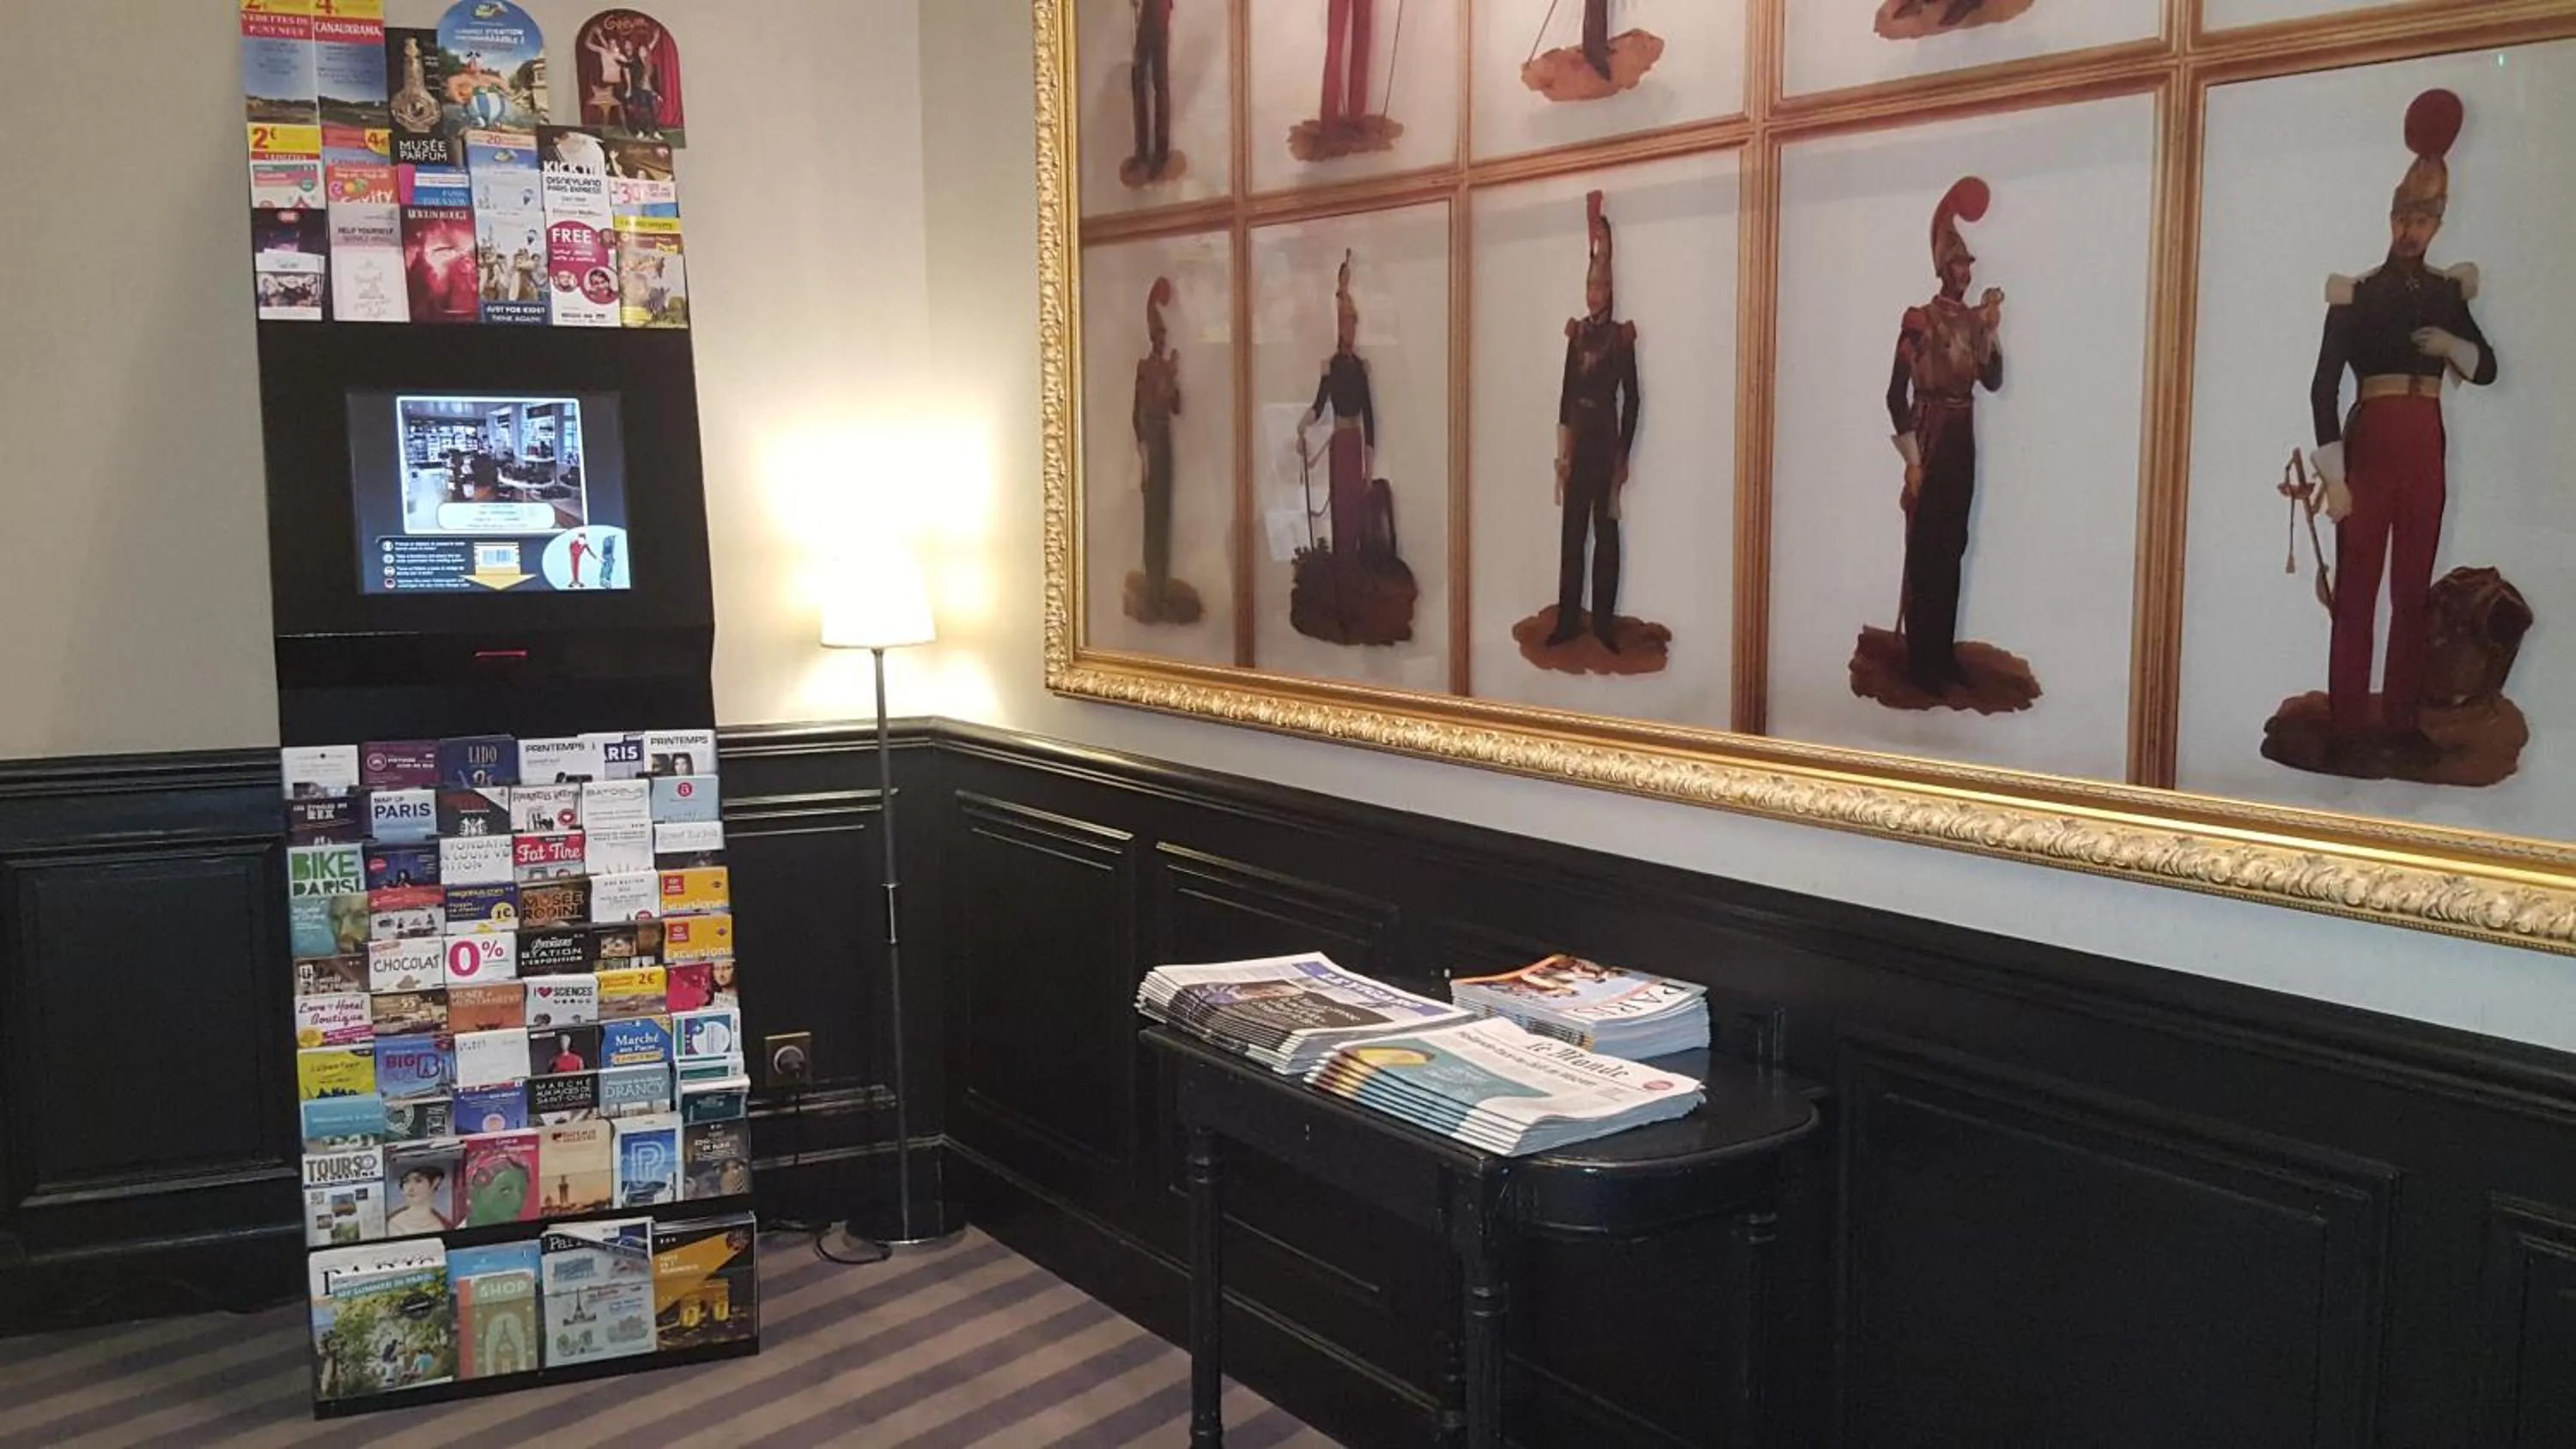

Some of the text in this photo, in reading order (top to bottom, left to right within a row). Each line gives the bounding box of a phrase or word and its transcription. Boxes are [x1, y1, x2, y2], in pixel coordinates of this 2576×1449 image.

[399, 150, 448, 161] PARFUM
[552, 228, 592, 244] FREE
[525, 740, 586, 753] PRINTEMPS
[649, 735, 709, 746] PRINTEMPS
[468, 746, 498, 763] LIDO
[374, 802, 432, 820] PARIS
[516, 842, 582, 861] Fat Tire
[292, 850, 359, 881] BIKE
[665, 945, 732, 959] Excursions
[373, 955, 440, 973] CHOCOLAT
[553, 986, 592, 997] SCIENCES
[615, 1032, 660, 1046] Marché
[386, 1055, 416, 1069] BIG
[604, 1082, 665, 1099] DRANCY
[478, 1280, 528, 1299] SHOP
